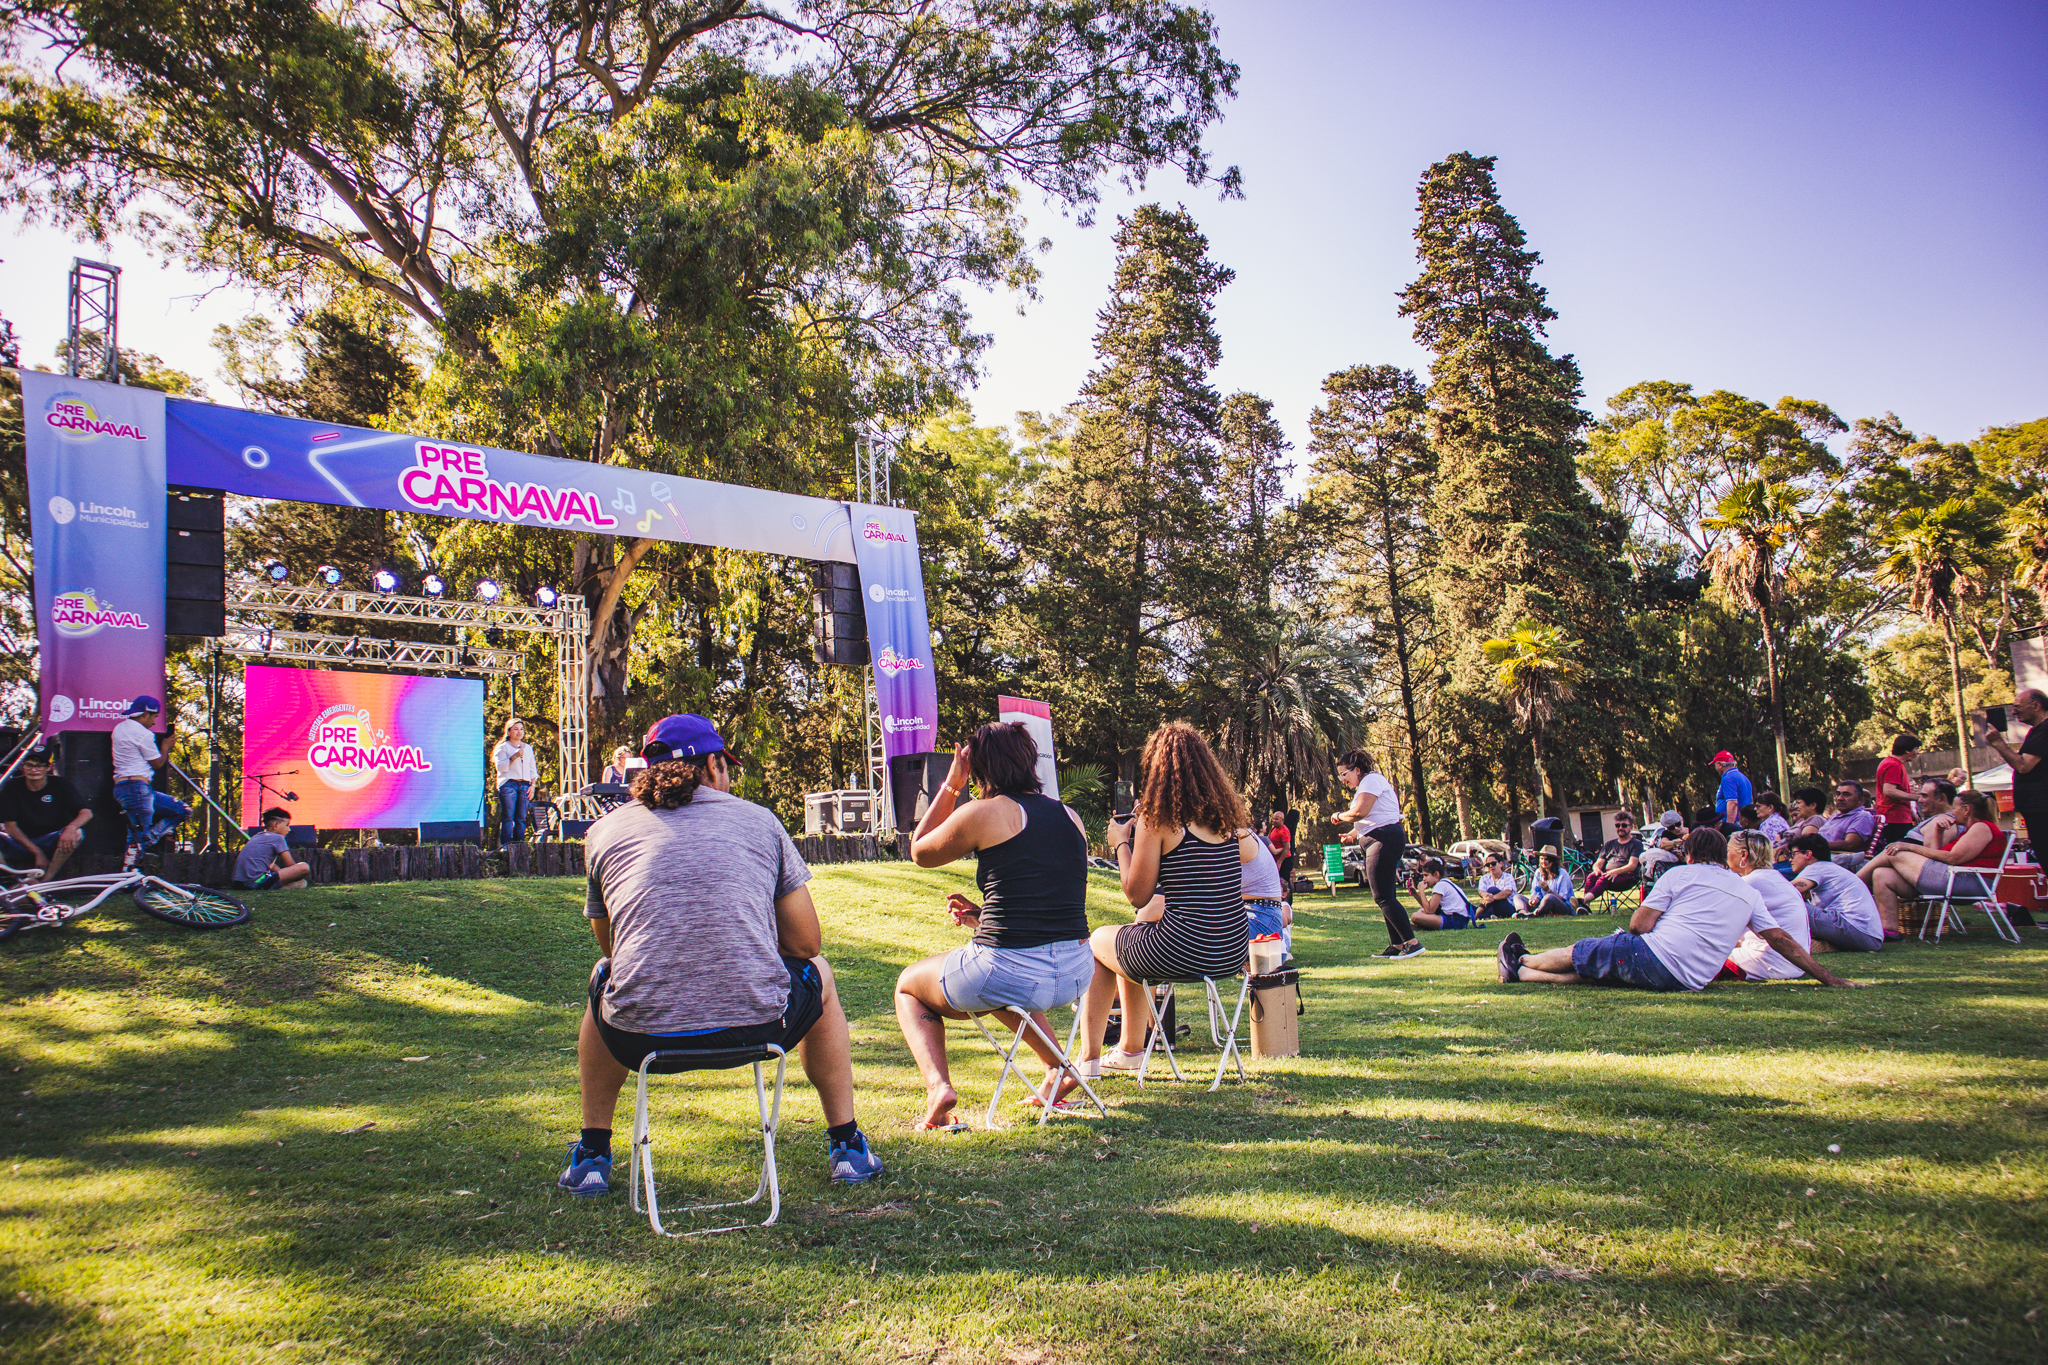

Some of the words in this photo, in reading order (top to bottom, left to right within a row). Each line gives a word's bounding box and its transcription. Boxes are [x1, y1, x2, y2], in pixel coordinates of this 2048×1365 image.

[56, 402, 85, 417] PRE
[47, 412, 148, 440] CARNAVAL
[420, 445, 484, 476] PRE
[403, 469, 615, 526] CARNAVAL
[79, 501, 137, 519] Lincoln
[79, 513, 149, 529] Municipalidad
[866, 522, 880, 530] PRE
[863, 529, 909, 543] CARNAVAL
[56, 597, 85, 609] PRE
[308, 715, 324, 742] ARTISTAS
[321, 703, 356, 719] EMERGENTES
[892, 715, 923, 726] Lincoln
[322, 727, 357, 743] PRE
[311, 745, 431, 770] CARNAVAL
